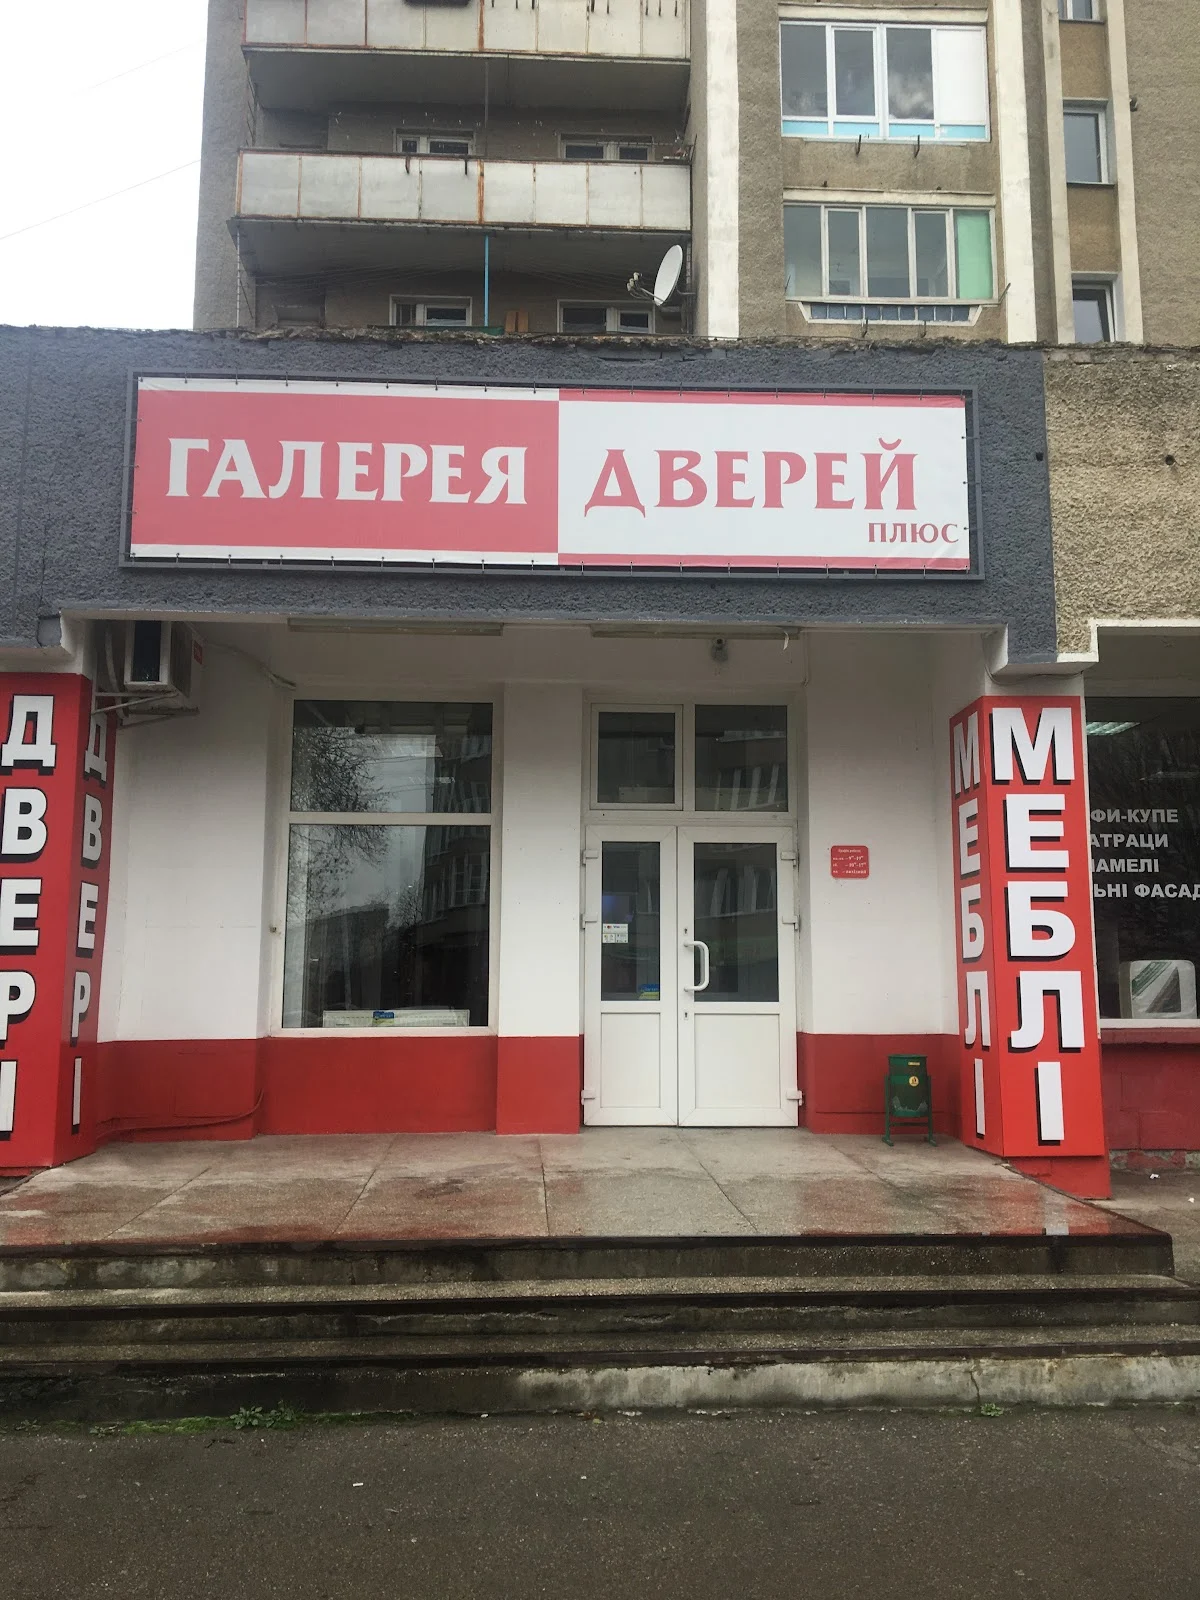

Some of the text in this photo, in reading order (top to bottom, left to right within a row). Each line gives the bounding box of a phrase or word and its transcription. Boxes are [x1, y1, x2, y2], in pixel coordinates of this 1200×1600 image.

[166, 437, 919, 518] ГАЛЕРЕЯ ДВЕРЕЙ
[868, 522, 960, 544] ПЛЮС
[0, 694, 57, 1133] ДВЕРІ
[71, 711, 108, 1127] ДВЕРІ
[952, 711, 991, 1137] МЕБЛІ
[990, 706, 1085, 1143] МЕБЛІ
[1090, 808, 1179, 823] ФИ-КУПЕ
[1091, 858, 1160, 873] АМЕЛІ
